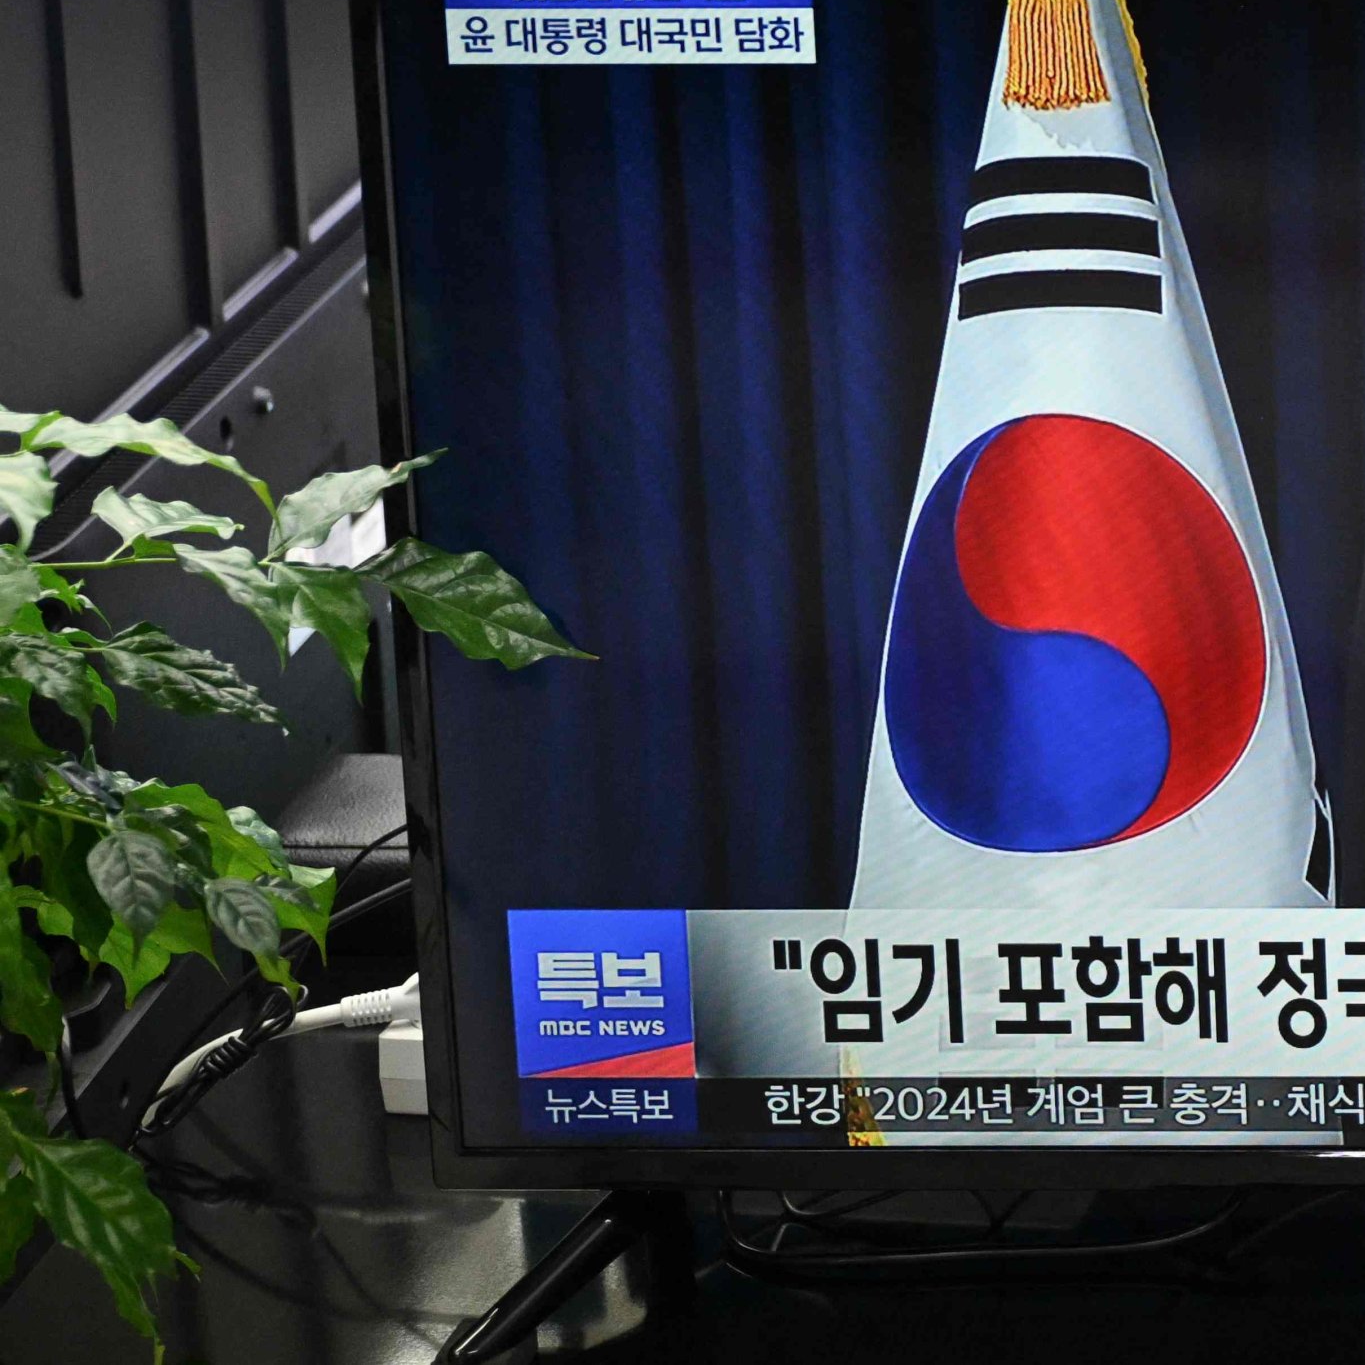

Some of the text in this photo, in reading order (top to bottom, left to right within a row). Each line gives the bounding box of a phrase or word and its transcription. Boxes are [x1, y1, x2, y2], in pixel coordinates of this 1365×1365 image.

[460, 15, 804, 56] 윤 대통령 대국민 담화
[536, 950, 665, 1010] 특보
[772, 935, 962, 1045] "임기
[993, 933, 1230, 1044] 포함해
[539, 1019, 666, 1038] MBC NEWS
[544, 1087, 674, 1123] 뉴스특보
[764, 1084, 843, 1126] 한강
[857, 1084, 1015, 1126] "2024년
[1026, 1084, 1106, 1125] 계엄
[1119, 1086, 1159, 1124] 큰
